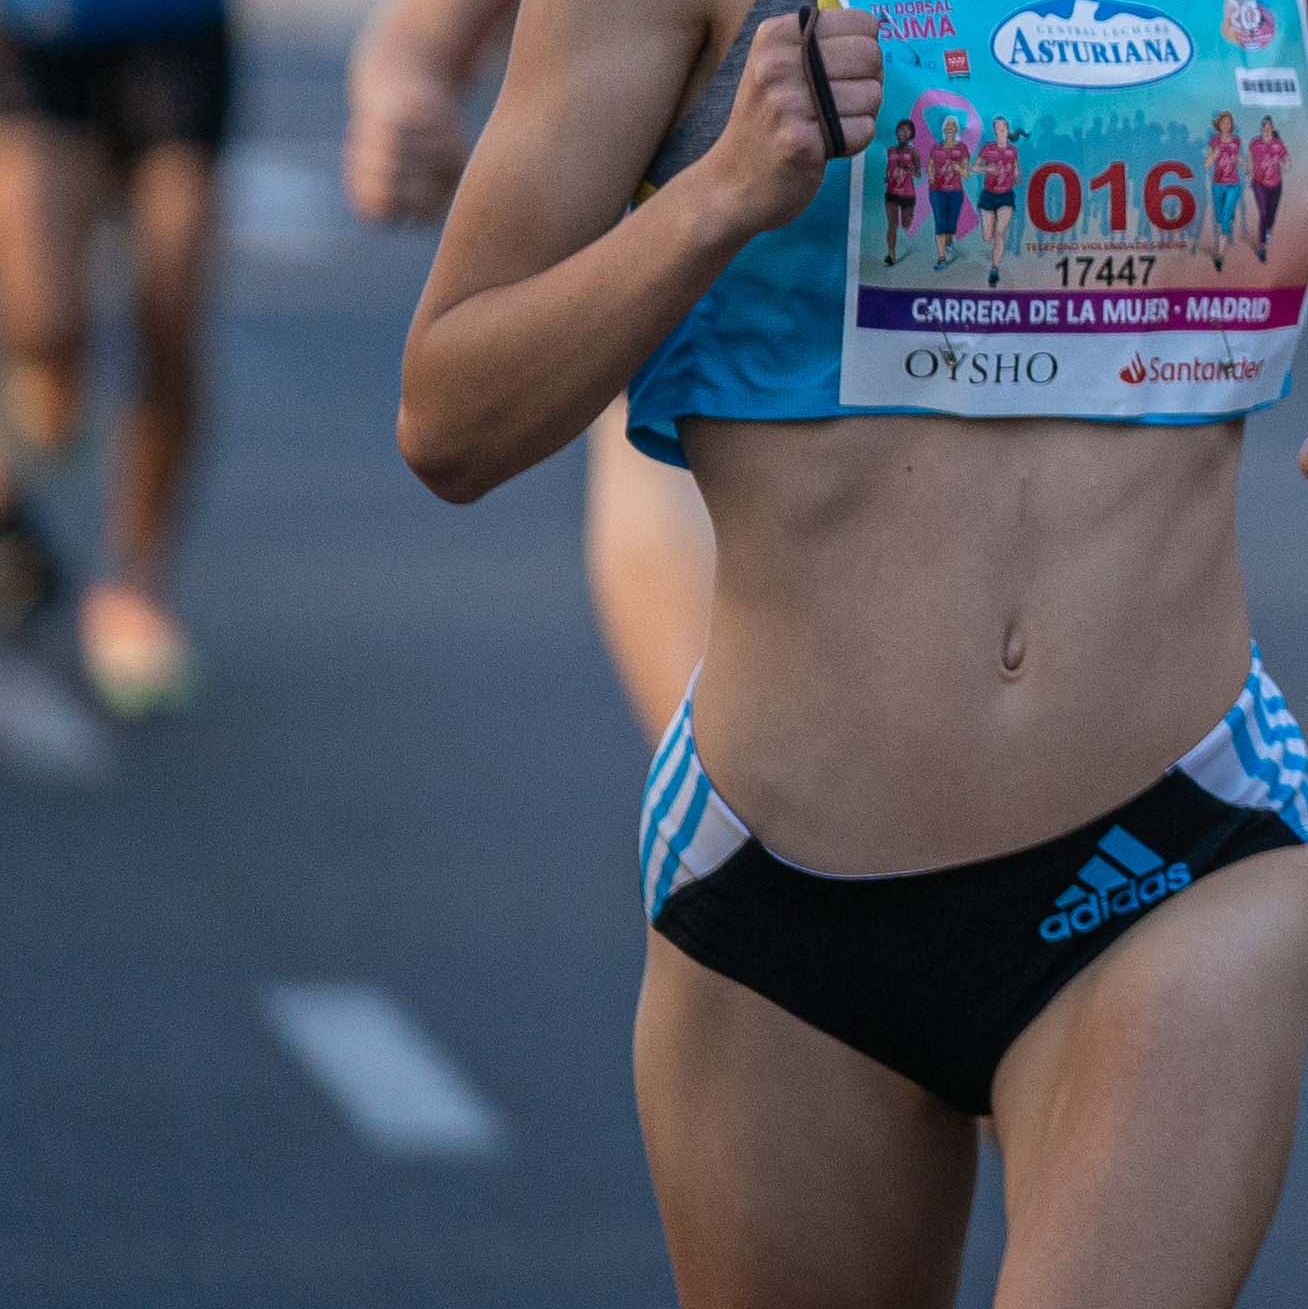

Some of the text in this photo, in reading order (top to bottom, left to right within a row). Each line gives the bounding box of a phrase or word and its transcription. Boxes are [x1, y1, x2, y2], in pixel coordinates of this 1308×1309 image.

[894, 0, 952, 15] DORSAL
[878, 14, 956, 41] SUMA
[1010, 26, 1181, 64] ASTURIANA
[1027, 160, 1196, 233] 016
[1055, 256, 1156, 286] 17447
[911, 296, 1272, 324] CARRERA DE LA MUJER MADRID
[904, 348, 1059, 384] OYSHO
[1149, 356, 1264, 382] Santander
[1039, 862, 1192, 942] adidas
